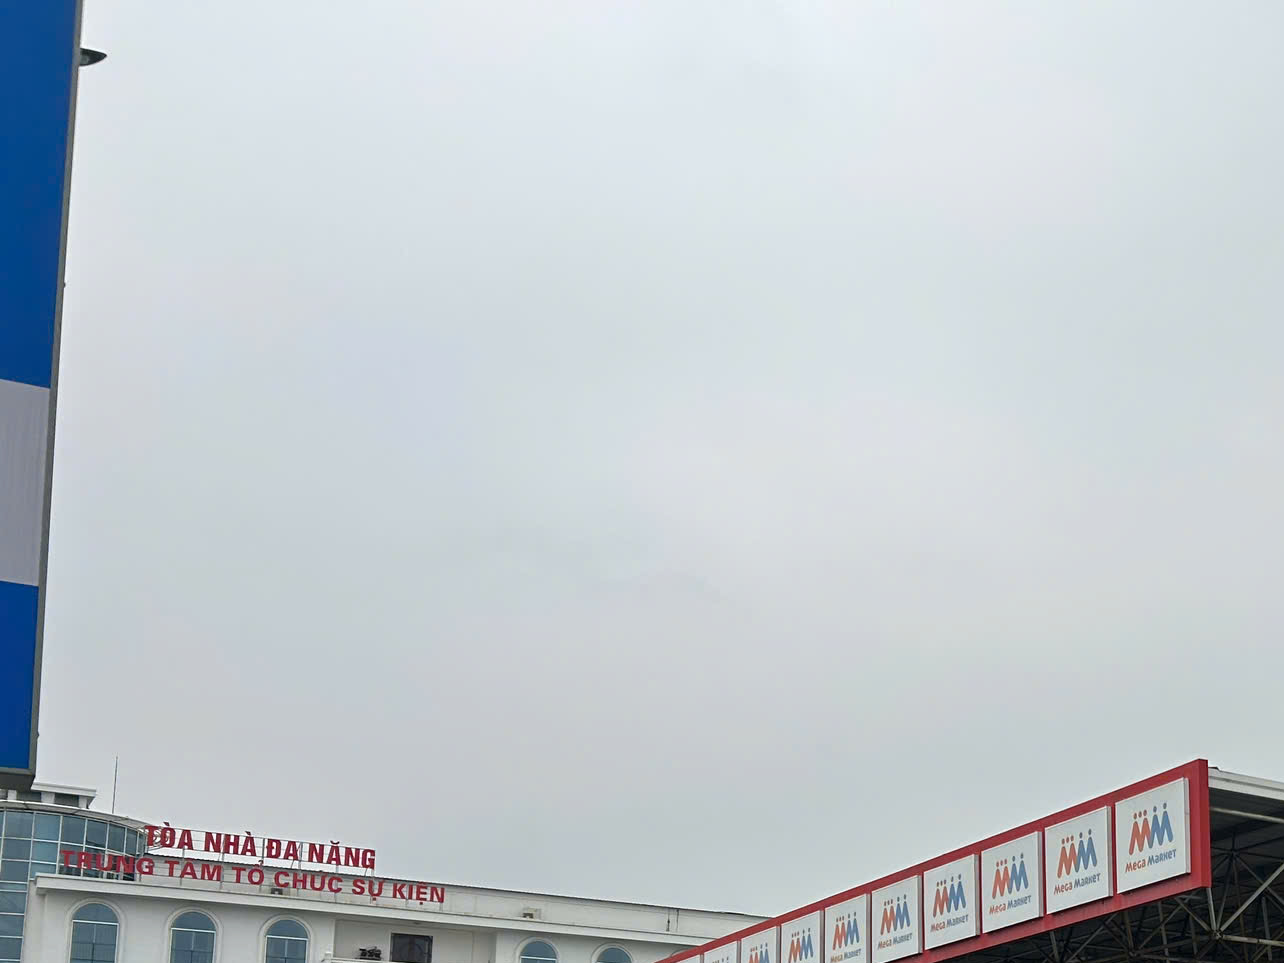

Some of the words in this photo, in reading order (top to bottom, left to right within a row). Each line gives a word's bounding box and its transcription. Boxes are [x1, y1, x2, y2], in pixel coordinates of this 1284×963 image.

[145, 821, 194, 850] TÒA
[205, 831, 257, 857] NHÀ
[266, 838, 299, 861] ĐA
[308, 840, 375, 869] NĂNG
[61, 850, 155, 875] TRUNG
[231, 860, 265, 885] TỔ
[352, 878, 384, 901] SỰ
[392, 881, 445, 905] KIỆN
